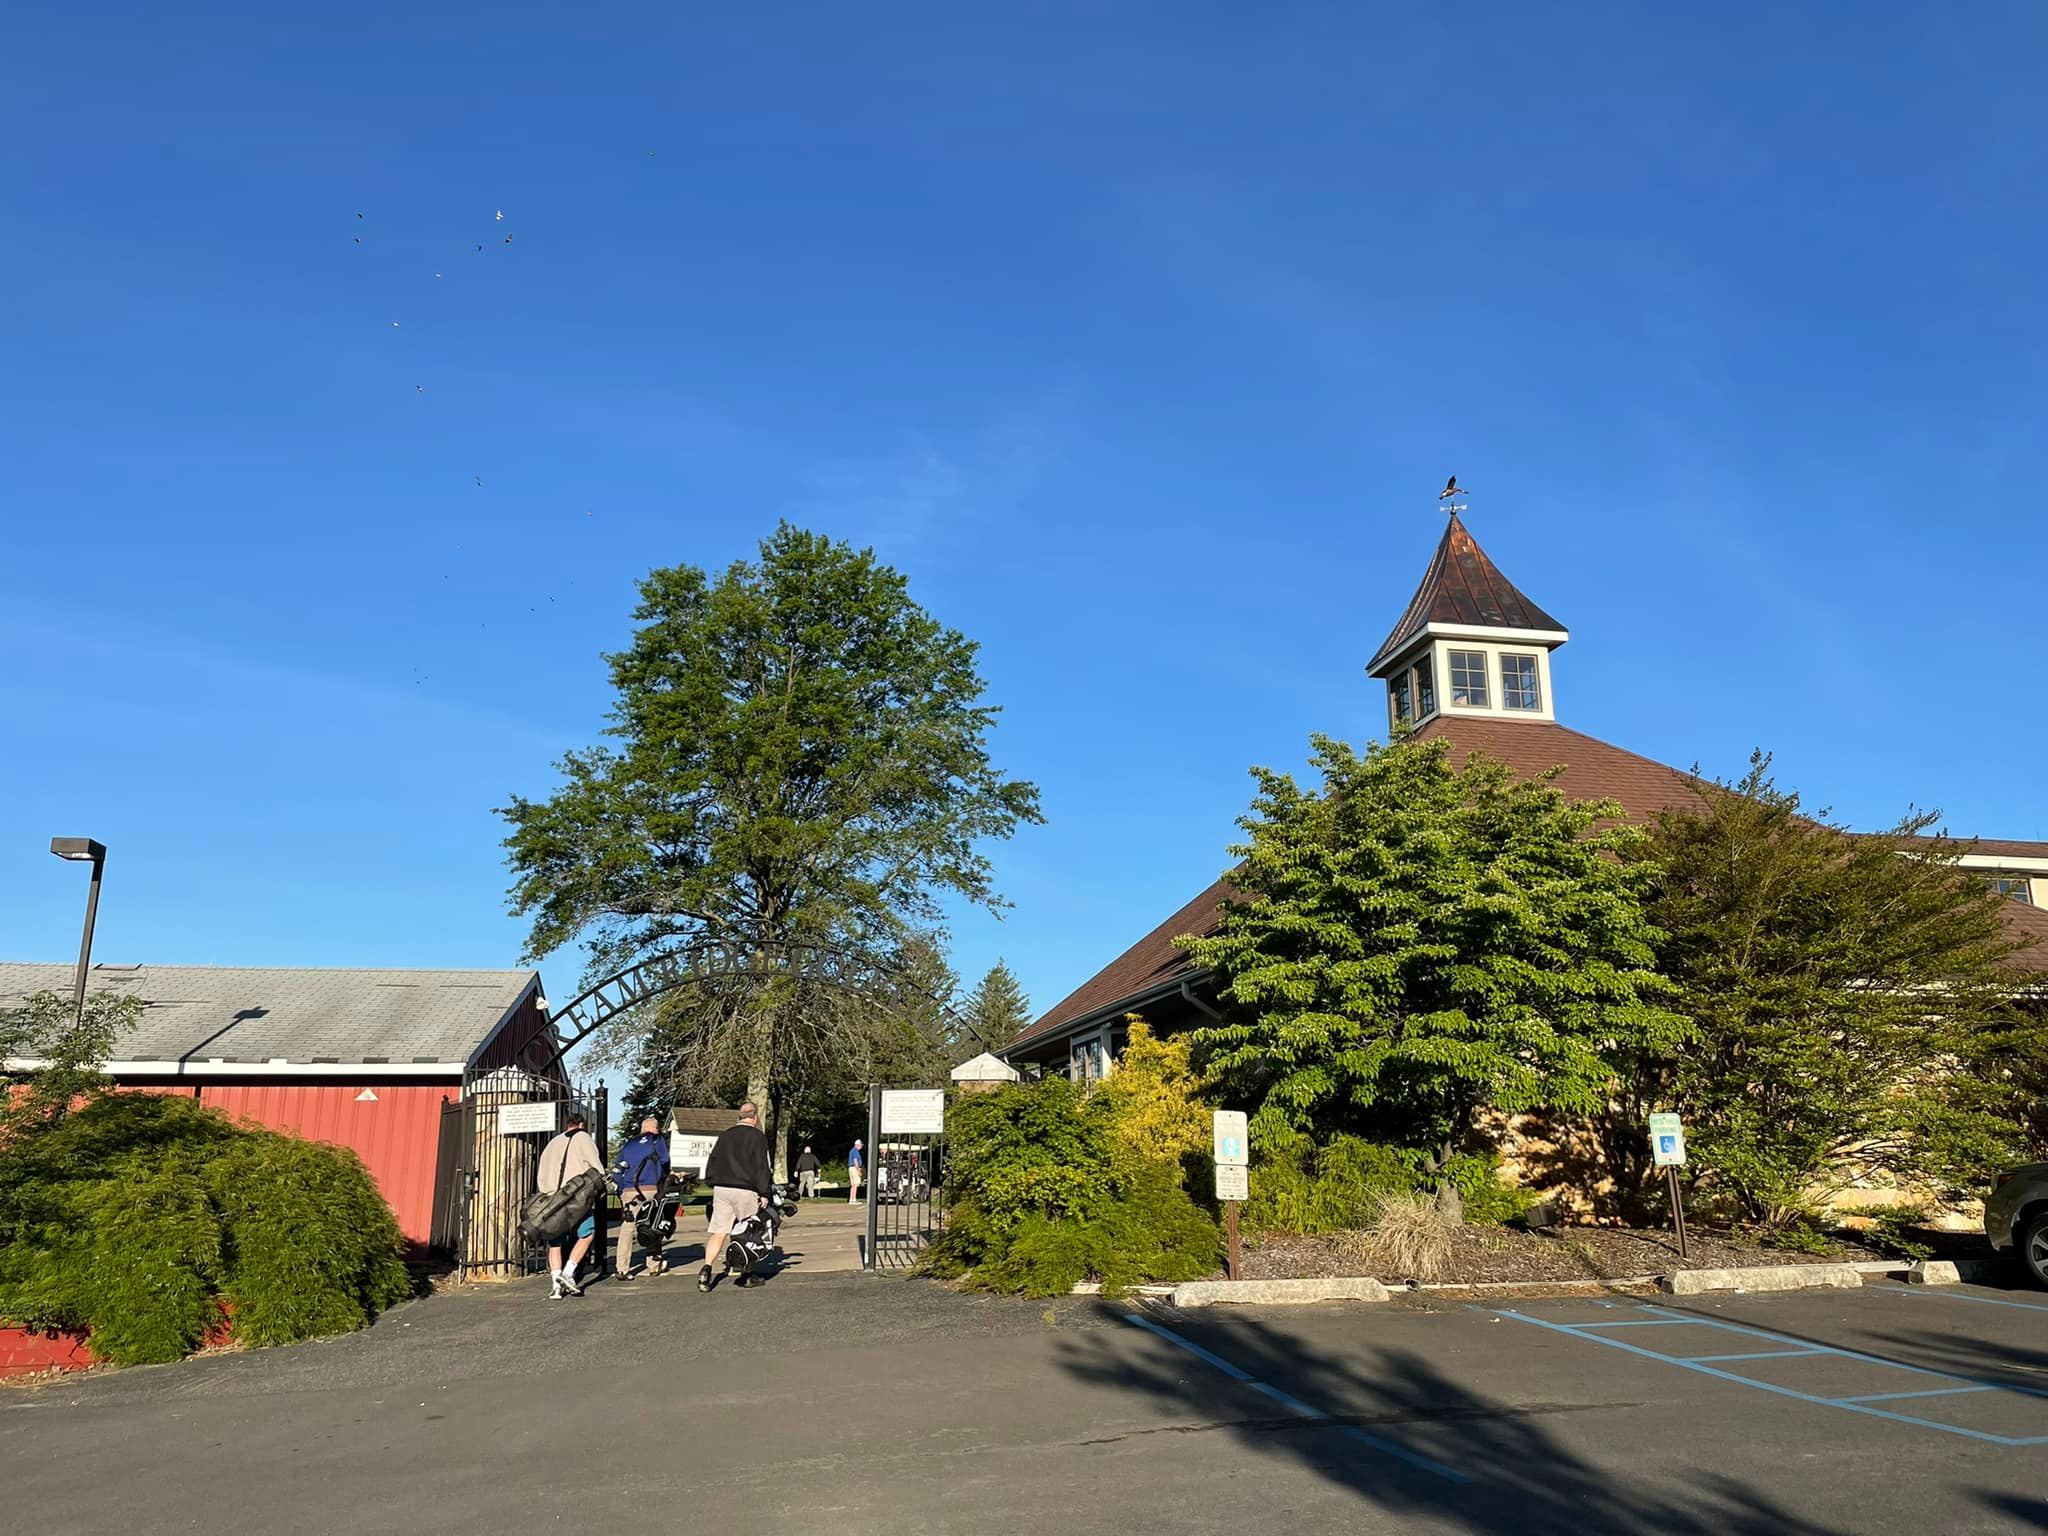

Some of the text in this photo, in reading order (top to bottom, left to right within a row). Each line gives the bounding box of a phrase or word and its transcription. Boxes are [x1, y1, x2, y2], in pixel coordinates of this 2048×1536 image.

[523, 968, 652, 1071] CREAM
[658, 942, 789, 988] RIDGE
[791, 947, 892, 993] GOLF
